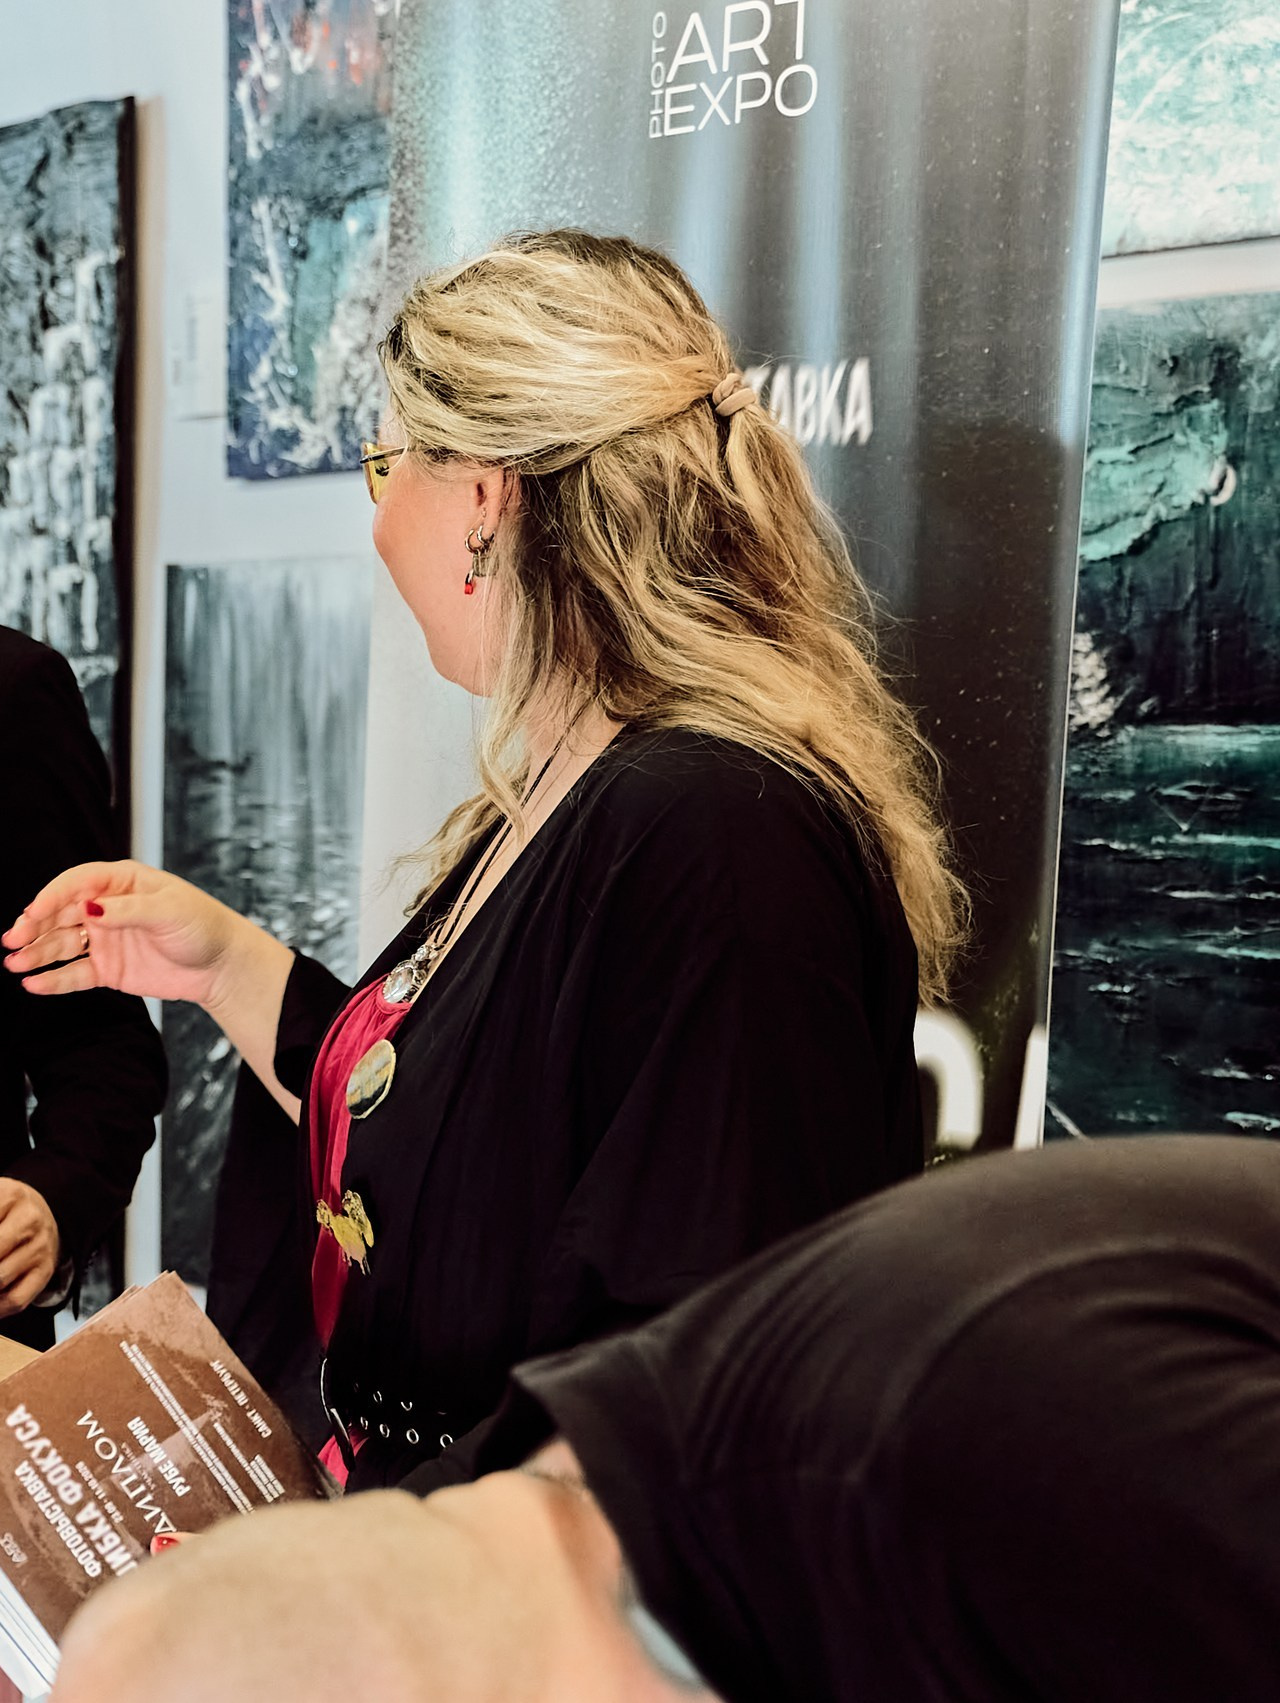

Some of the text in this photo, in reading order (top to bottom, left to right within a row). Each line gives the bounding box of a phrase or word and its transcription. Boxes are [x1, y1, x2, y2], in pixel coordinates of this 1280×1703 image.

[649, 11, 667, 138] PHOTO
[663, 63, 818, 136] EXPO
[666, 0, 805, 83] ART
[3, 1400, 139, 1577] ИБКА ФОКУСА
[75, 1407, 177, 1534] ДИПЛОМ
[125, 1414, 192, 1498] РУБЕ МАРИЯ
[13, 1458, 105, 1579] ФОТОВЫСТАВКА
